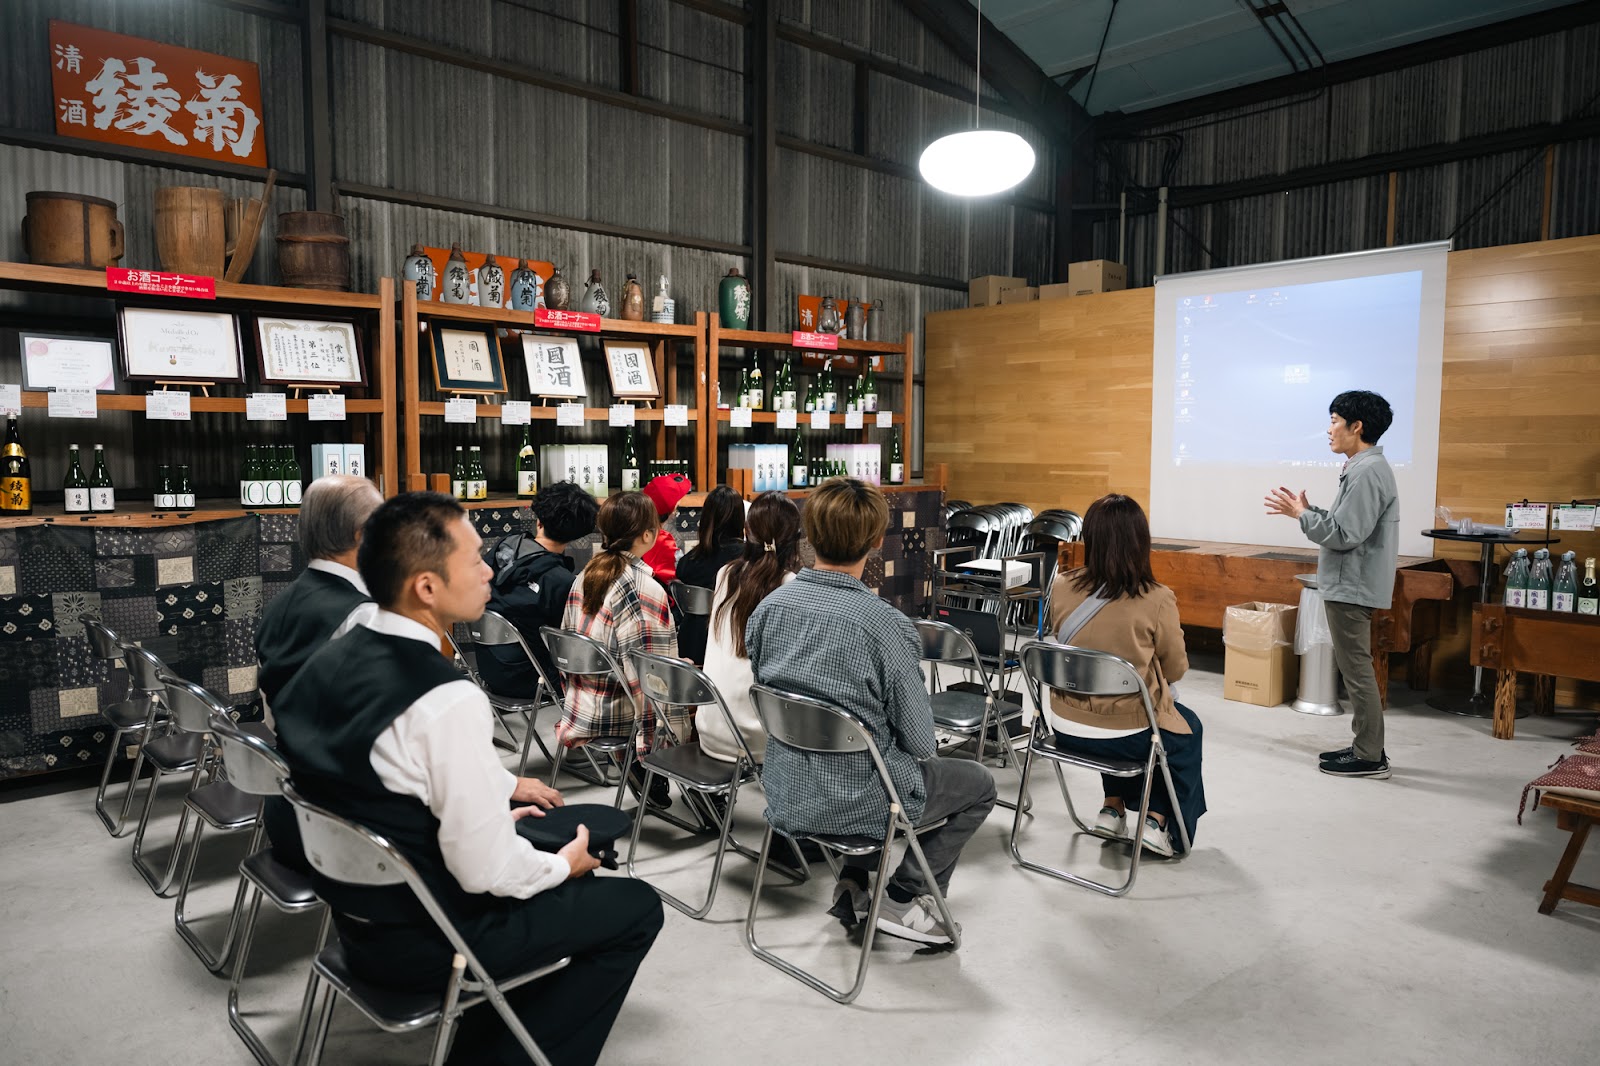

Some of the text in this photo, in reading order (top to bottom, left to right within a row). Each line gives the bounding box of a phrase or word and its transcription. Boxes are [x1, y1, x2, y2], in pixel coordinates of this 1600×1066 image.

[55, 43, 87, 127] 清酒
[84, 56, 261, 158] 綾菊
[127, 269, 196, 286] お酒コーナー
[547, 310, 589, 321] お酒コーナー
[800, 332, 830, 342] お酒コーナー
[308, 340, 321, 369] 第三位
[334, 343, 345, 363] 賞状
[10, 480, 23, 506] 綾菊
